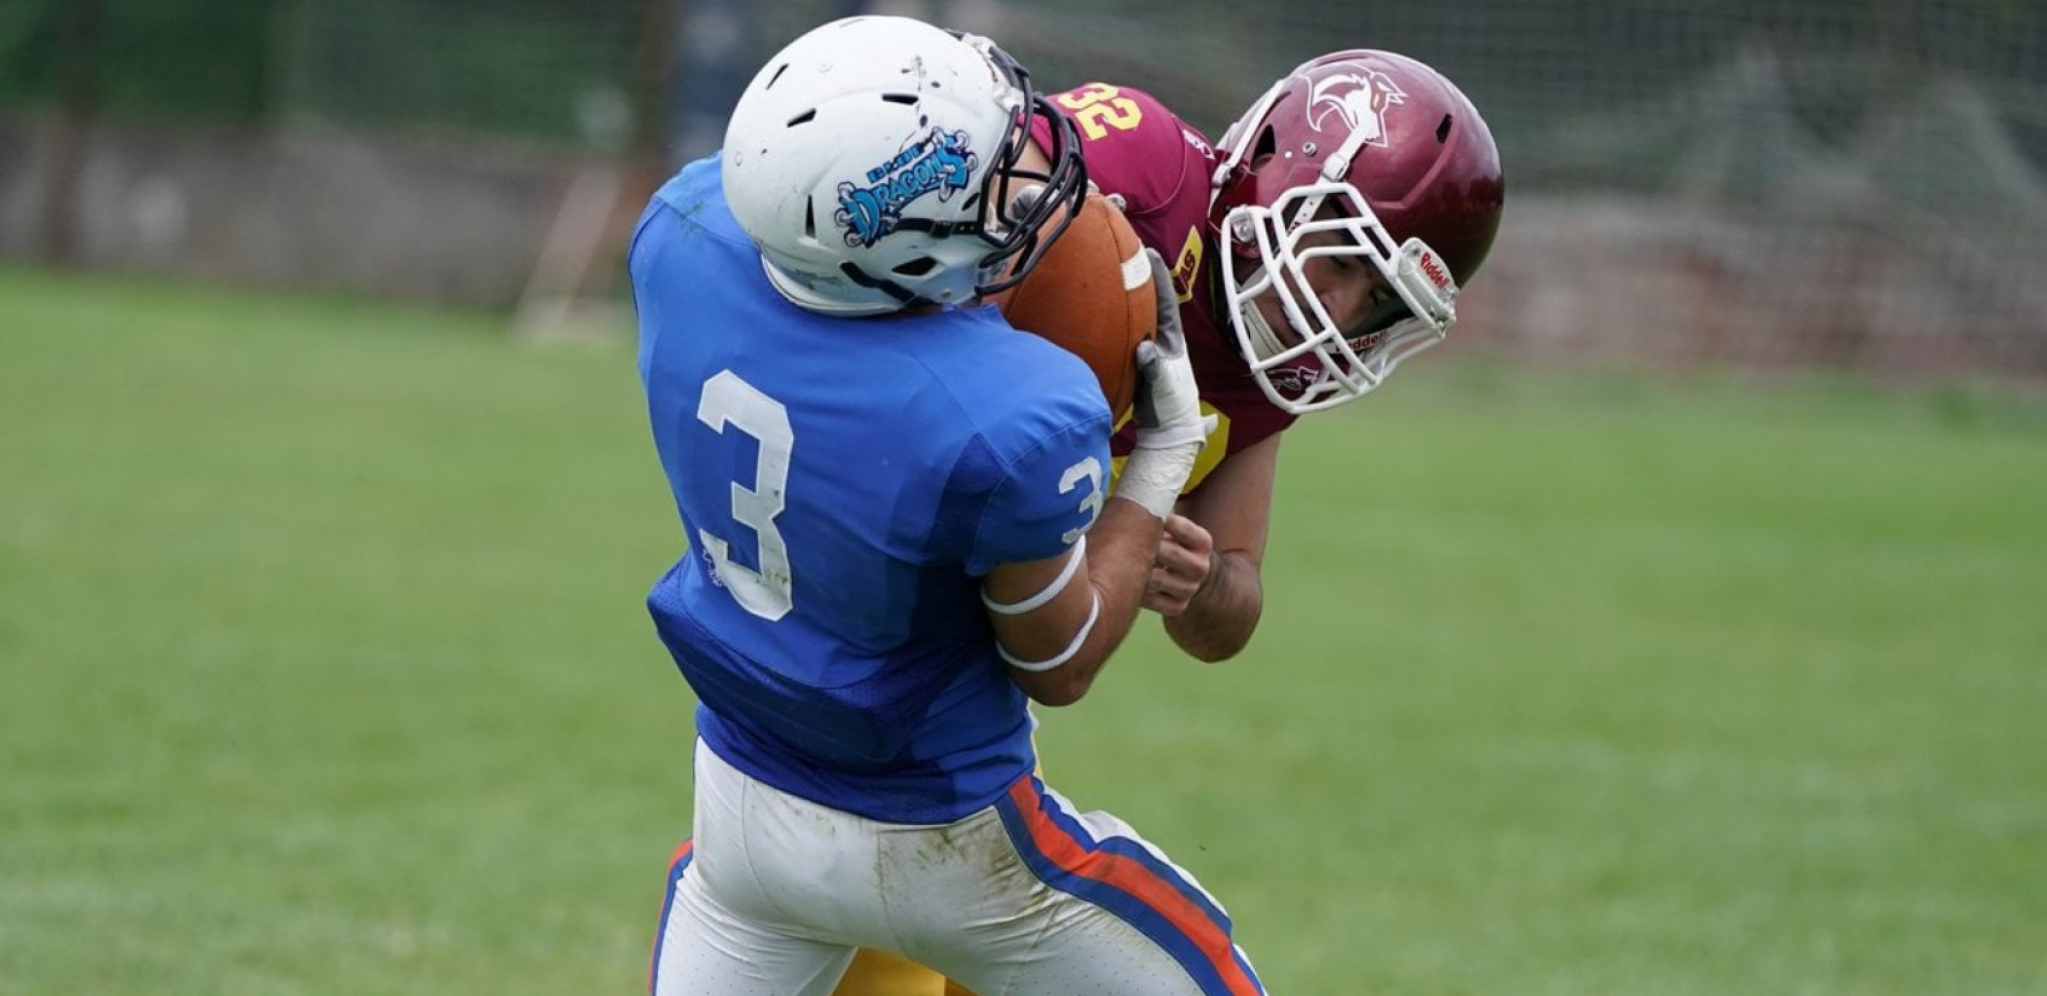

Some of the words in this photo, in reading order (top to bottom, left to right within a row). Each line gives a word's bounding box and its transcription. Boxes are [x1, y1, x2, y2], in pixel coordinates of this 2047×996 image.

[1058, 82, 1142, 141] 32
[841, 134, 970, 247] DRAGONS
[697, 369, 794, 622] 3
[1058, 456, 1103, 544] 3
